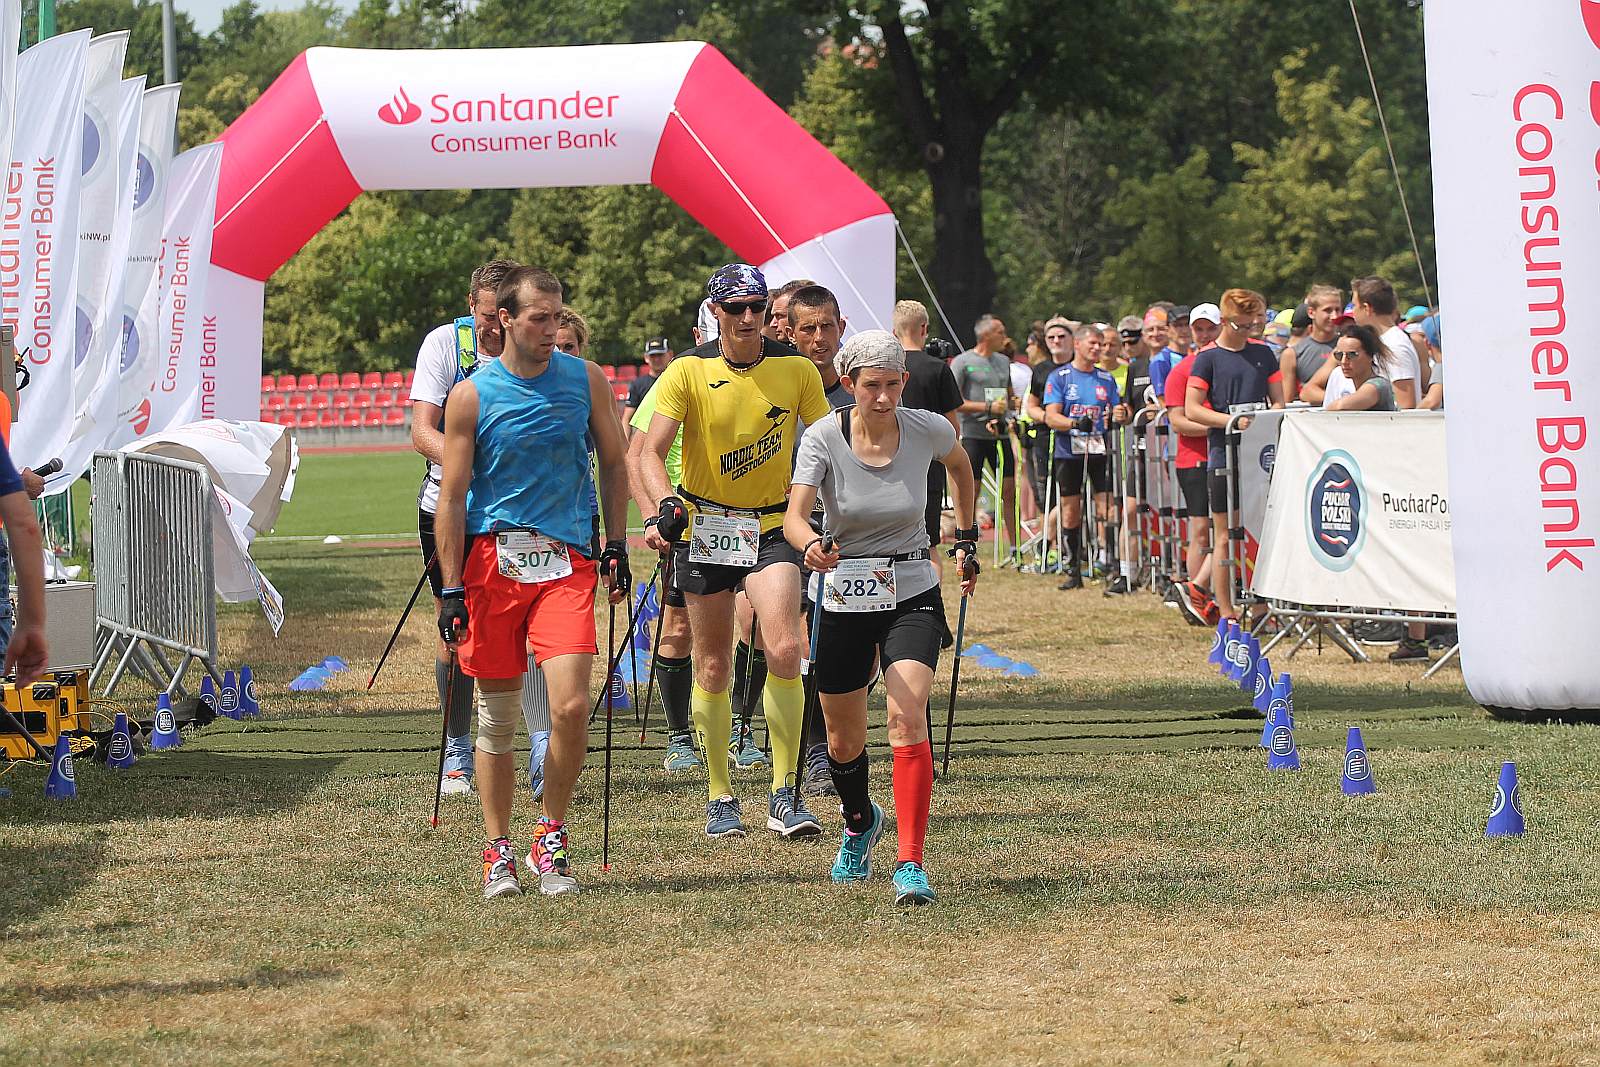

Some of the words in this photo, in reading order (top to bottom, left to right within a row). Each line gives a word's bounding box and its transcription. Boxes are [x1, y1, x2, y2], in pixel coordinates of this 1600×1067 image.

[431, 90, 619, 124] Santander
[431, 132, 552, 153] Consumer
[558, 128, 617, 149] Bank
[31, 157, 55, 224] Bank
[171, 236, 191, 286] Bank
[1513, 83, 1573, 402] Consumer
[29, 230, 52, 366] Consumer
[162, 289, 187, 392] Consumer
[200, 315, 217, 367] Bank
[719, 444, 755, 475] NORDIC
[756, 430, 783, 456] TEAM
[1321, 505, 1352, 523] POLSKI
[1536, 416, 1596, 573] Bank
[516, 550, 552, 568] 307
[708, 534, 742, 552] 301
[842, 578, 879, 597] 282
